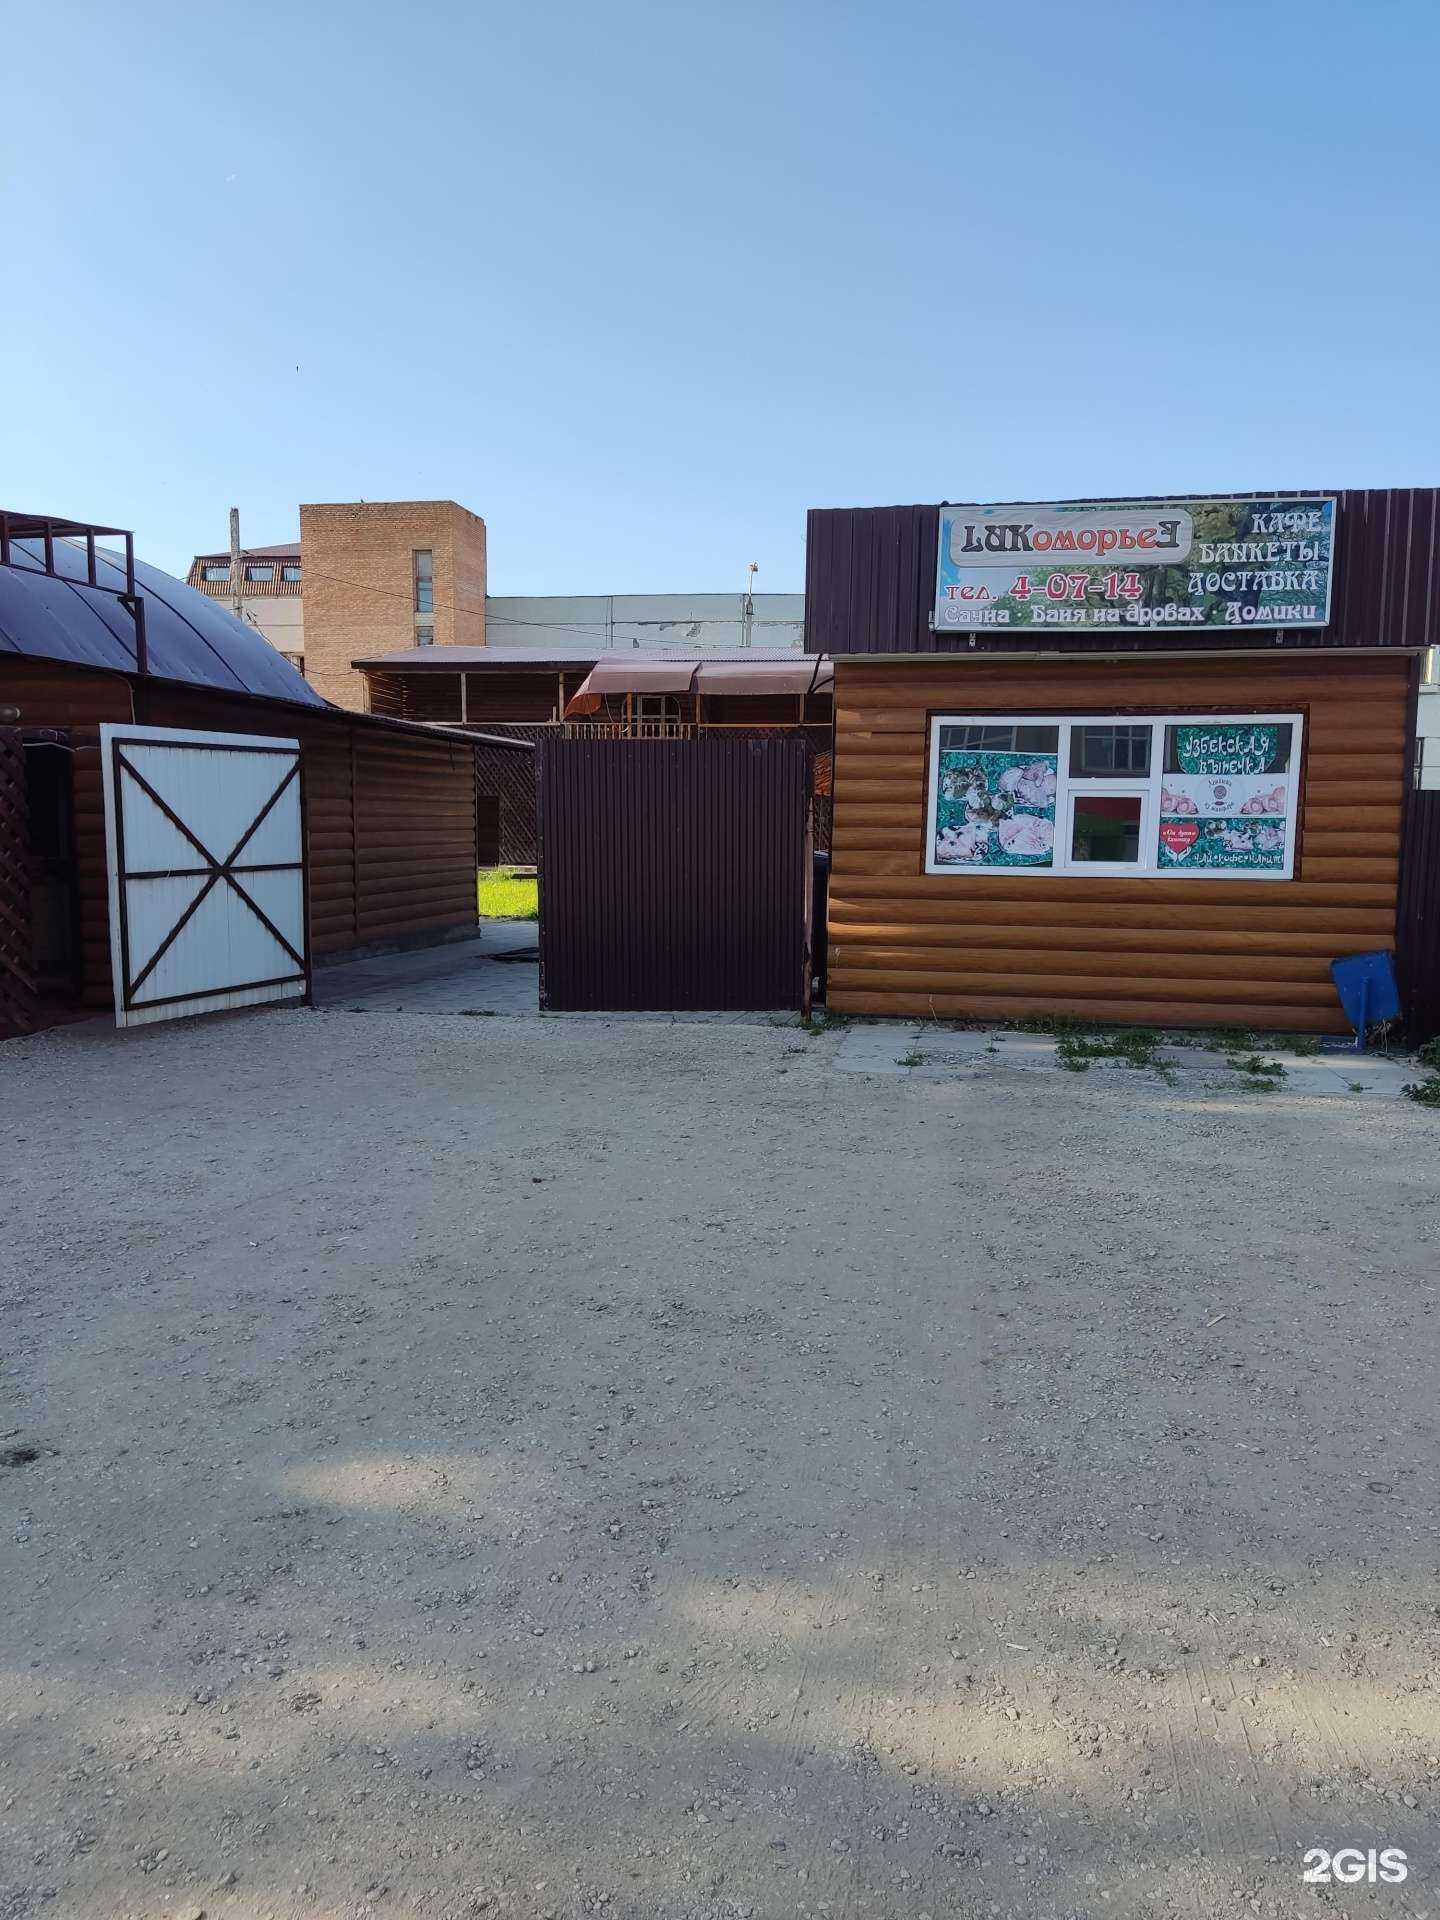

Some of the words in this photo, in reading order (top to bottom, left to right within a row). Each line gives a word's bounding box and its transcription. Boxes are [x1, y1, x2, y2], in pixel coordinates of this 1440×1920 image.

[1251, 512, 1323, 533] КАФЕ
[1199, 541, 1320, 562] БАНКЕТЫ
[945, 584, 999, 602] тел.
[1007, 572, 1143, 600] 4-07-14
[1187, 570, 1319, 596] ДОСТАВКА
[1030, 604, 1089, 623] Баня
[1092, 606, 1122, 622] на
[1124, 602, 1205, 625] дровах
[1224, 602, 1317, 624] Домики
[1183, 734, 1270, 758] УЗБЕКСКАЯ
[1199, 756, 1265, 775] ВЫПЕЧКА
